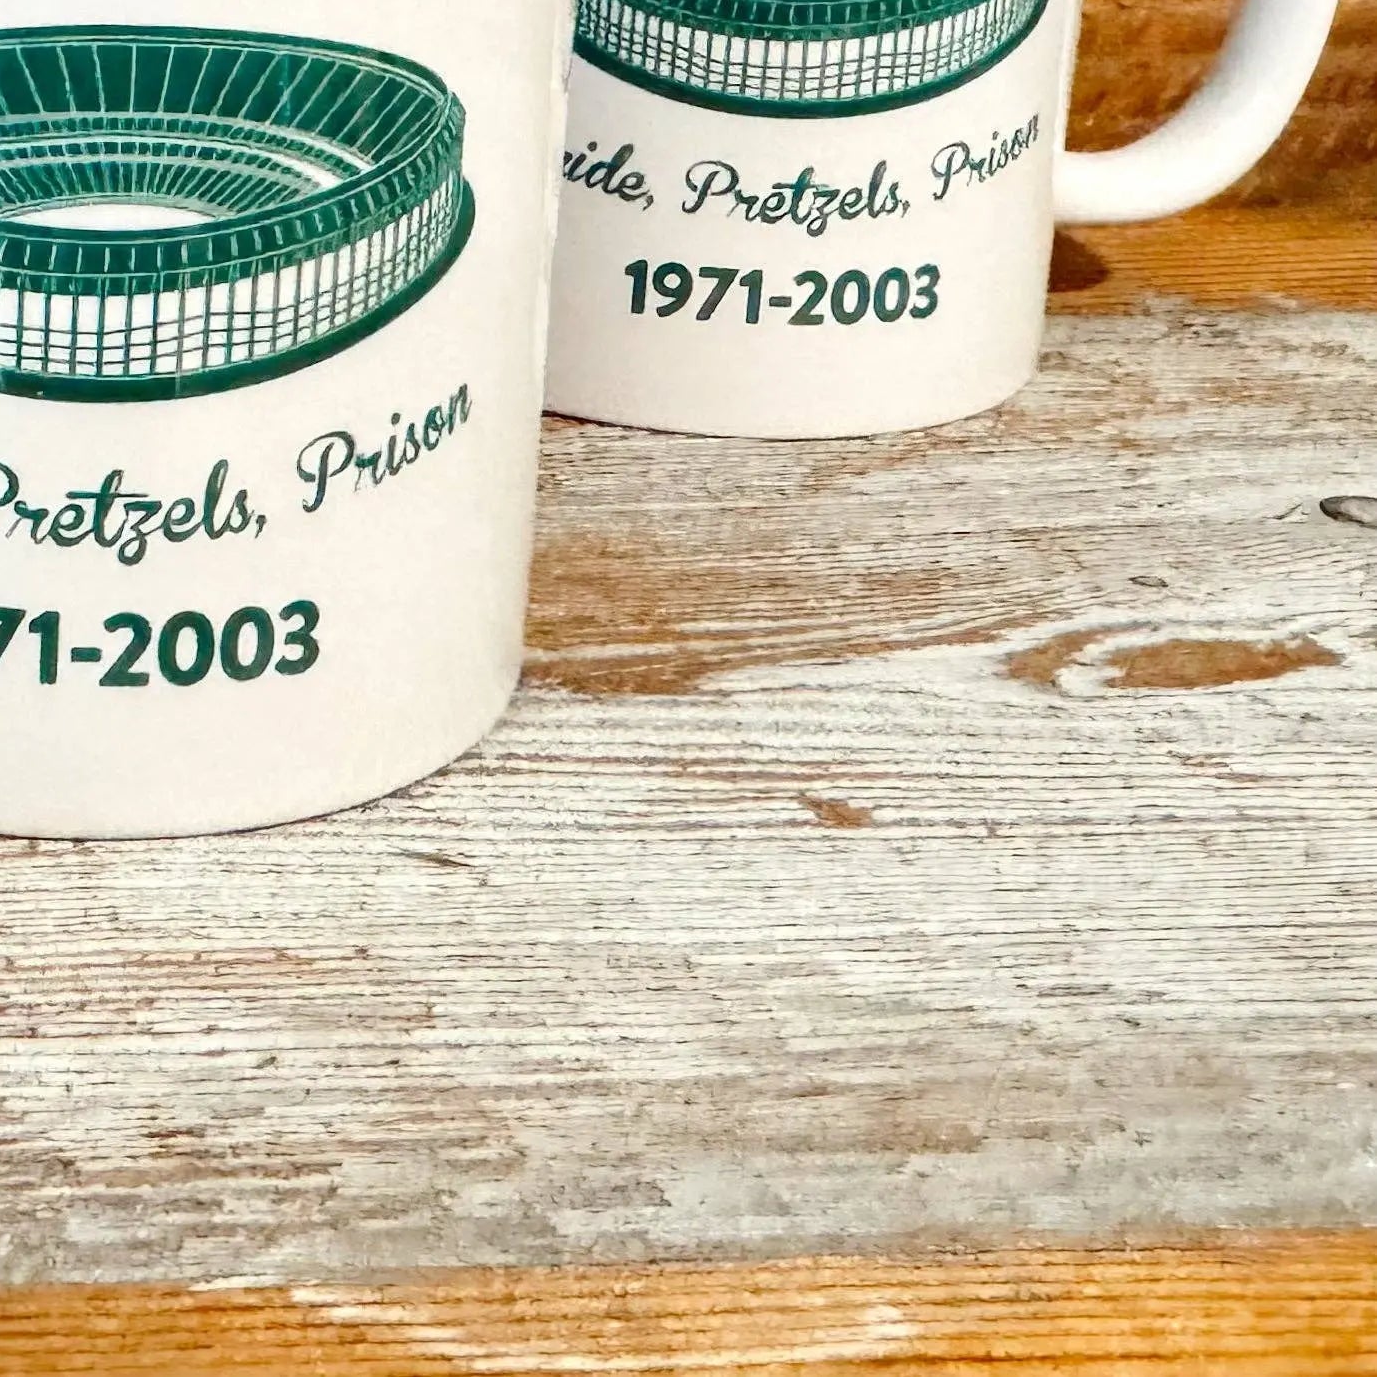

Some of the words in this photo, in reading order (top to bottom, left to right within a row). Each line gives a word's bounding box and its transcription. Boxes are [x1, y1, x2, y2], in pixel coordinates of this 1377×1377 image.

[681, 159, 910, 238] Pretzels,
[931, 111, 1040, 203] Prison
[623, 258, 942, 327] 1971-2003
[297, 379, 474, 514] Prison
